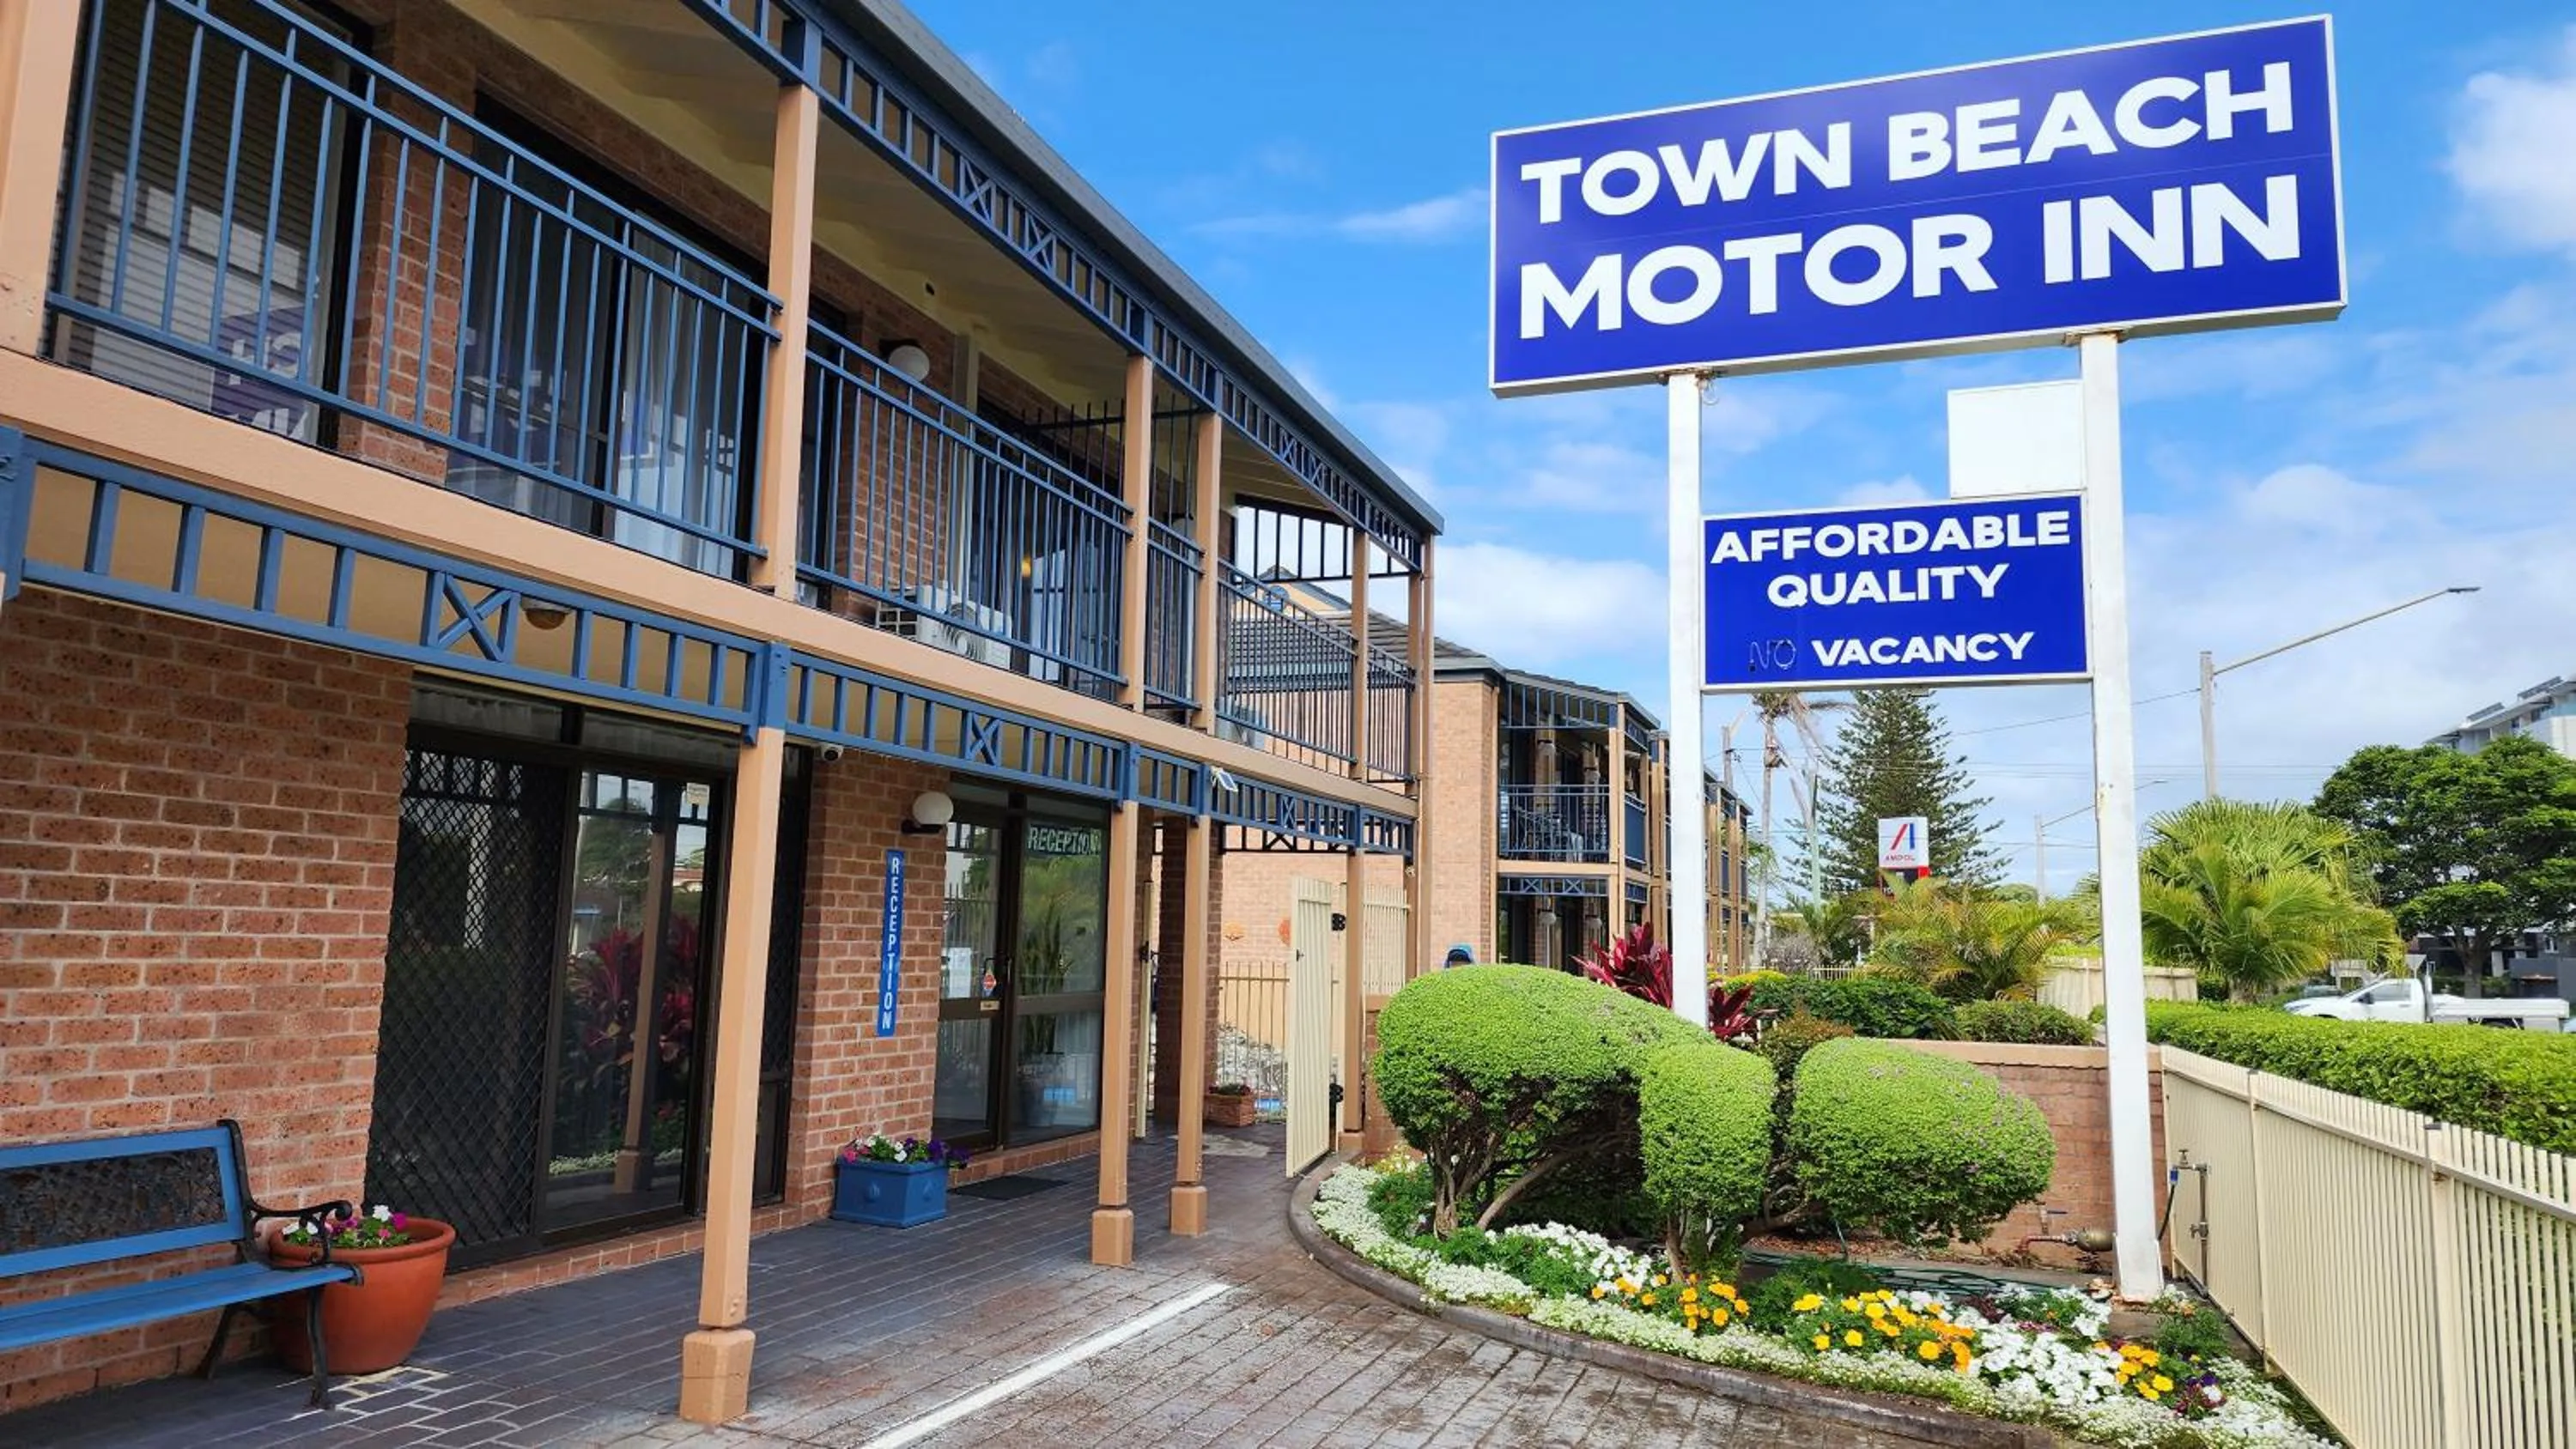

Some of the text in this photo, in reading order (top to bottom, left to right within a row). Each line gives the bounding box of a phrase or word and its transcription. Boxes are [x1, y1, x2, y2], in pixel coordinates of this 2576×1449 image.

[1520, 61, 2293, 225] TOWN BEACH
[1520, 174, 2300, 339] MOTOR INN
[1710, 511, 2071, 565] AFFORDABLE
[1766, 563, 2009, 608] QUALITY
[1748, 631, 2035, 671] NO VACANCY
[1028, 827, 1101, 854] RECEPTION
[882, 857, 900, 1029] RECEPTION
